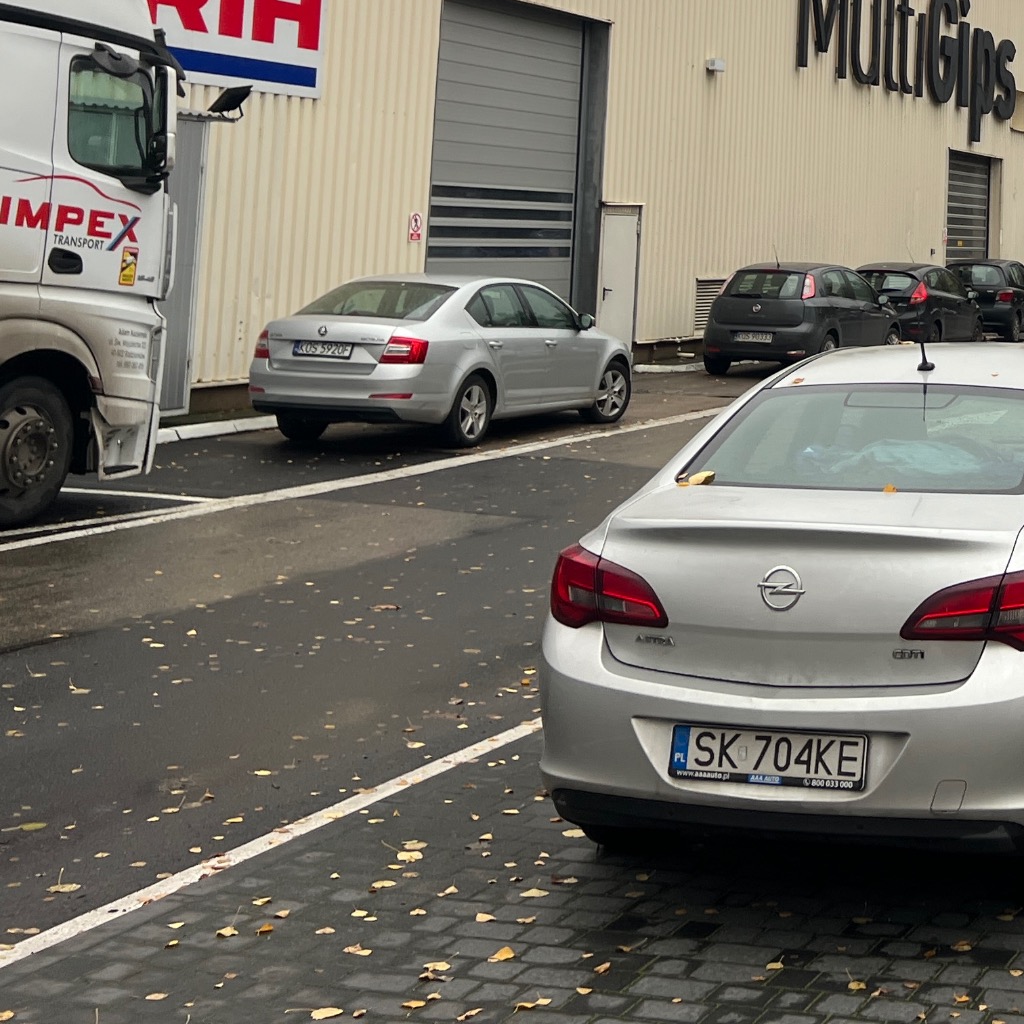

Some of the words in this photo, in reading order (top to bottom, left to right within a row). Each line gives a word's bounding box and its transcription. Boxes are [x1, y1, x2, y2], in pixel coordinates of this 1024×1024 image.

[53, 234, 105, 251] TRANSPORT
[674, 752, 685, 763] PL
[694, 731, 742, 769] SK
[752, 736, 859, 777] 704KE
[676, 770, 730, 781] www.aaaauto.pl
[811, 779, 825, 787] 800
[825, 780, 839, 788] 033
[839, 781, 854, 789] 000
